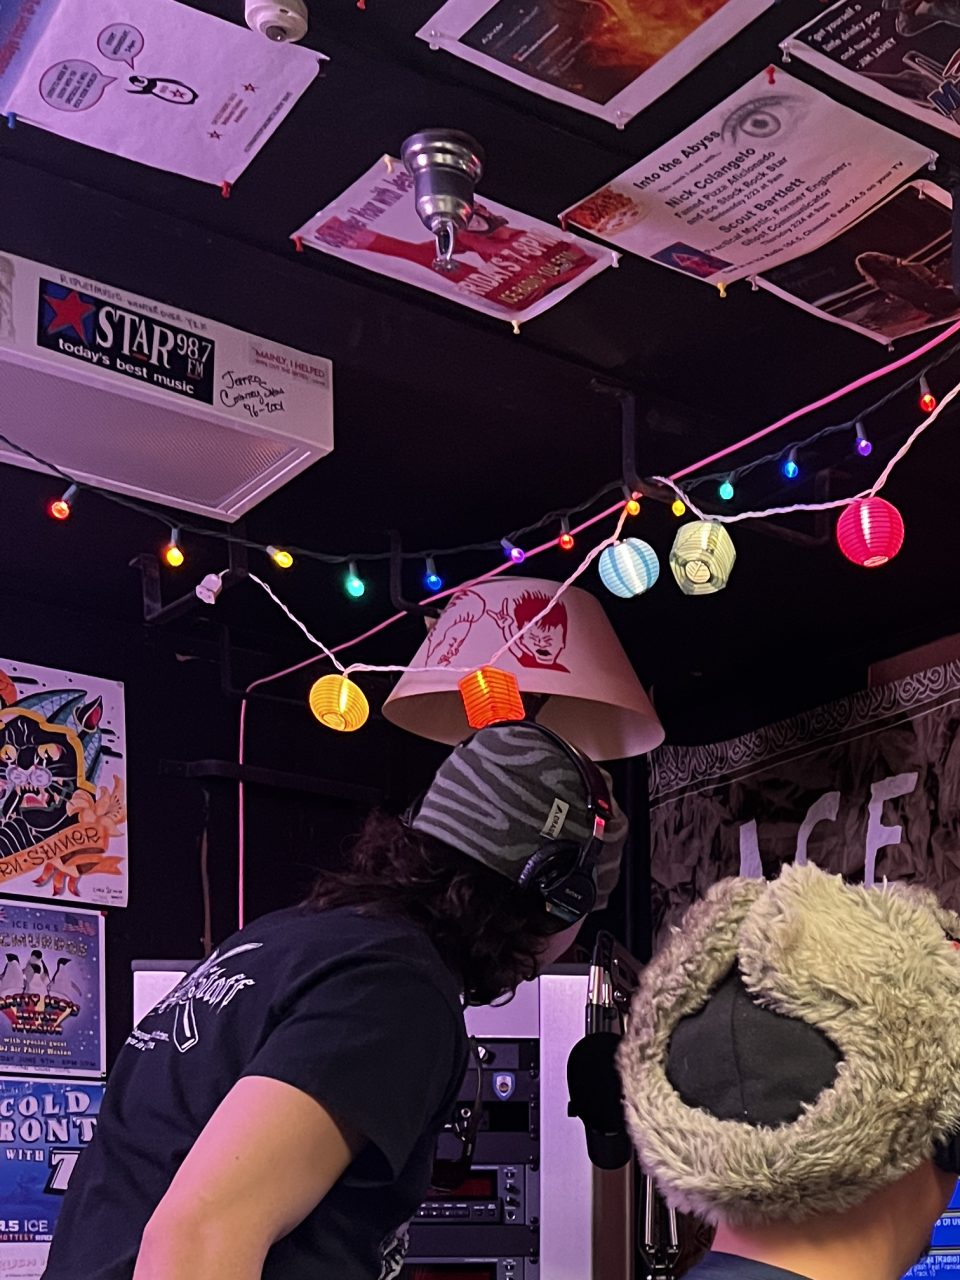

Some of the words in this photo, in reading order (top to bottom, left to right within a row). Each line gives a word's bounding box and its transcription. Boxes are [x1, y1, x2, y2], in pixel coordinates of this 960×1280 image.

[840, 47, 856, 60] and
[633, 171, 661, 191] Into
[662, 155, 682, 174] the
[680, 129, 722, 158] Abyss
[665, 188, 696, 209] Nick
[694, 146, 757, 193] Colangelo
[674, 200, 701, 220] Famed
[702, 182, 727, 204] Pizza
[727, 150, 776, 186] Aficionado
[686, 211, 703, 226] and
[744, 171, 768, 194] Rock
[768, 156, 789, 176] Star
[718, 208, 756, 235] Scout
[757, 177, 805, 213] Bartlett
[740, 229, 767, 248] Ghost
[767, 187, 832, 234] Communicator
[742, 213, 776, 238] Mystic,
[773, 192, 806, 223] Former
[806, 162, 852, 196] Engineer,
[58, 337, 110, 366] today's
[116, 357, 148, 380] best
[153, 372, 195, 395] music
[95, 305, 175, 369] STAR
[187, 357, 204, 378] FM
[294, 362, 325, 378] HELPED
[11, 921, 29, 930] ICE
[0, 1091, 90, 1116] COLD
[6, 1149, 43, 1160] WITH
[24, 1220, 48, 1232] ICE
